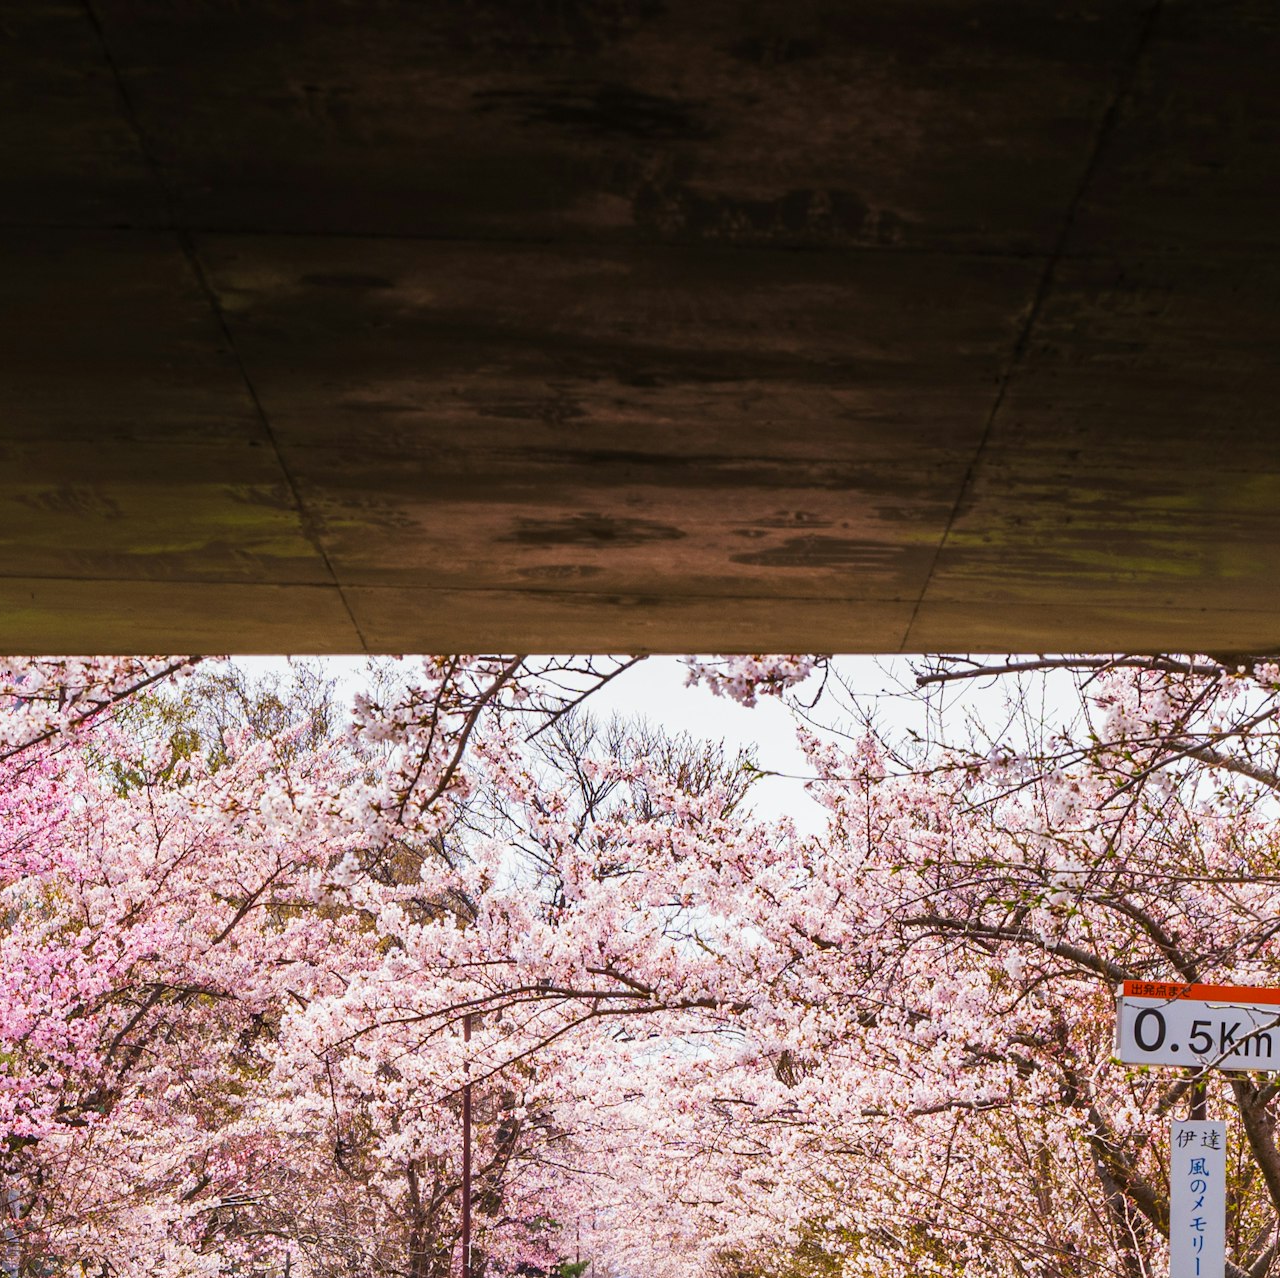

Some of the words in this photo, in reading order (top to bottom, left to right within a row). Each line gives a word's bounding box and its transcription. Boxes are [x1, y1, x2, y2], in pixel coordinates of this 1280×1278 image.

[1175, 1129, 1221, 1150] 伊達
[1188, 1157, 1209, 1276] 風のメモリー
